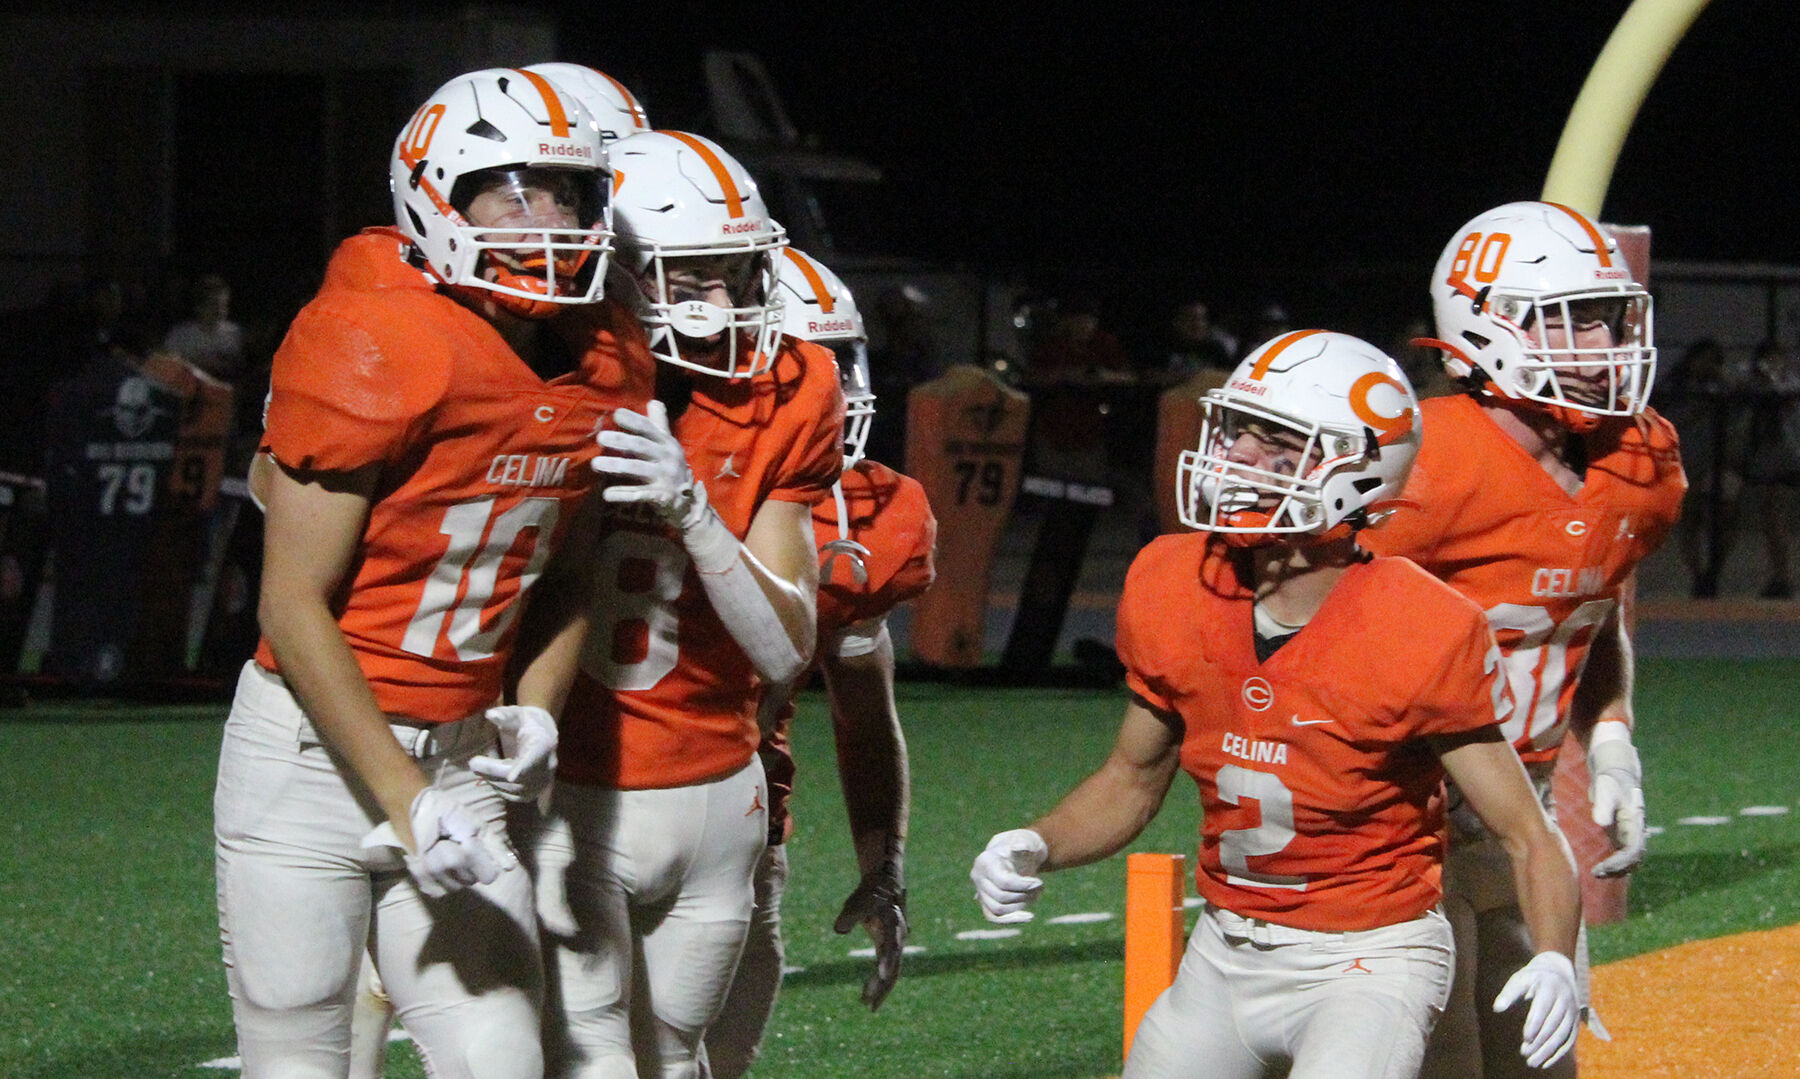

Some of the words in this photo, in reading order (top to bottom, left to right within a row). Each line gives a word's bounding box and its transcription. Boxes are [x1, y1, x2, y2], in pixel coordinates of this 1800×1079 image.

[399, 103, 447, 161] 10
[538, 142, 593, 159] Riddell
[722, 220, 764, 235] Riddell
[1450, 232, 1512, 283] 80
[807, 321, 854, 334] Riddell
[534, 405, 555, 423] C
[1348, 371, 1414, 433] C
[97, 463, 157, 516] 79
[485, 453, 571, 488] CELINA
[955, 460, 1004, 506] 79
[1565, 519, 1587, 536] C
[400, 496, 560, 662] 10
[1530, 567, 1606, 598] CELINA
[580, 529, 689, 690] 8
[1221, 731, 1288, 765] CELINA
[1215, 763, 1309, 892] 2
